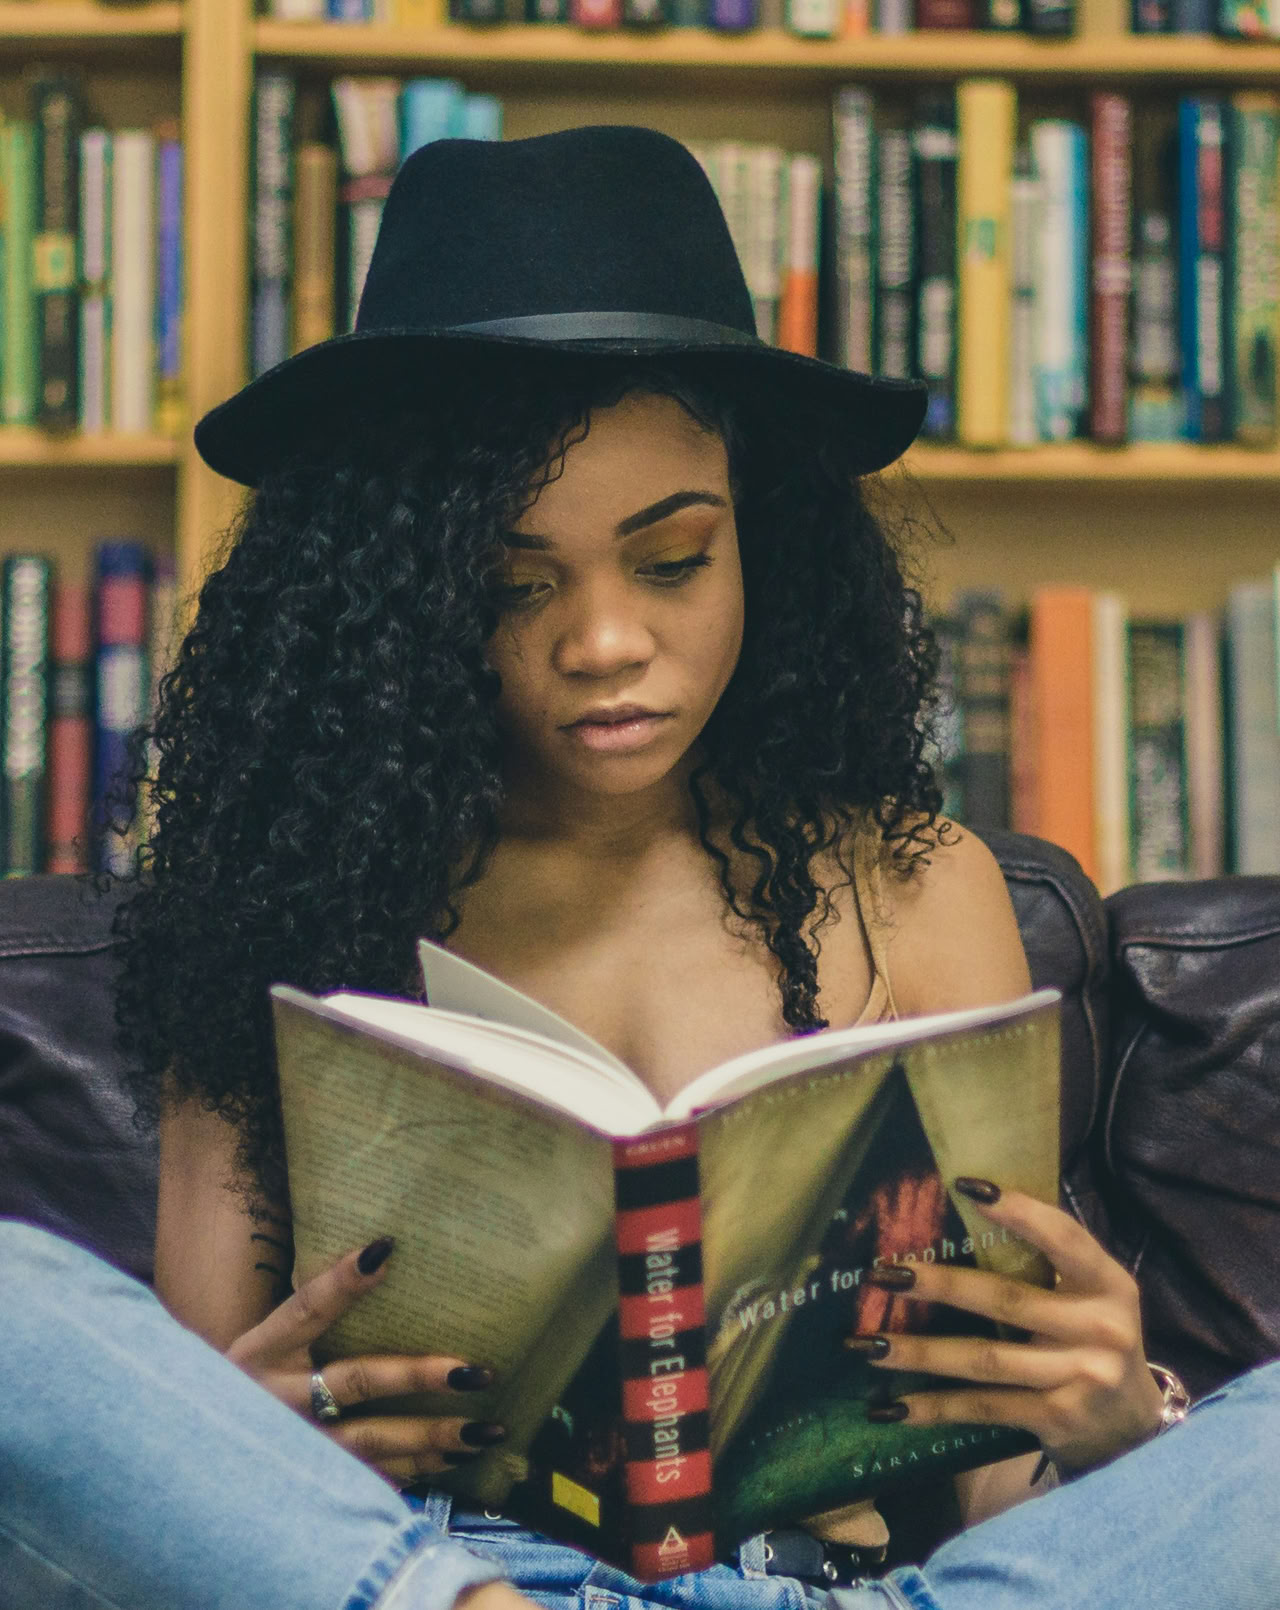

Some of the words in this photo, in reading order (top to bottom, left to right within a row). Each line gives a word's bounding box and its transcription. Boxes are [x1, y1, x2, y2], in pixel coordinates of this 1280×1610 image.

[645, 1227, 681, 1304] Water
[648, 1311, 684, 1348] for
[738, 1281, 820, 1331] Water
[830, 1267, 864, 1293] for
[645, 1355, 688, 1484] Elephants
[852, 1450, 918, 1478] SARA
[931, 1428, 1021, 1455] GRUE
